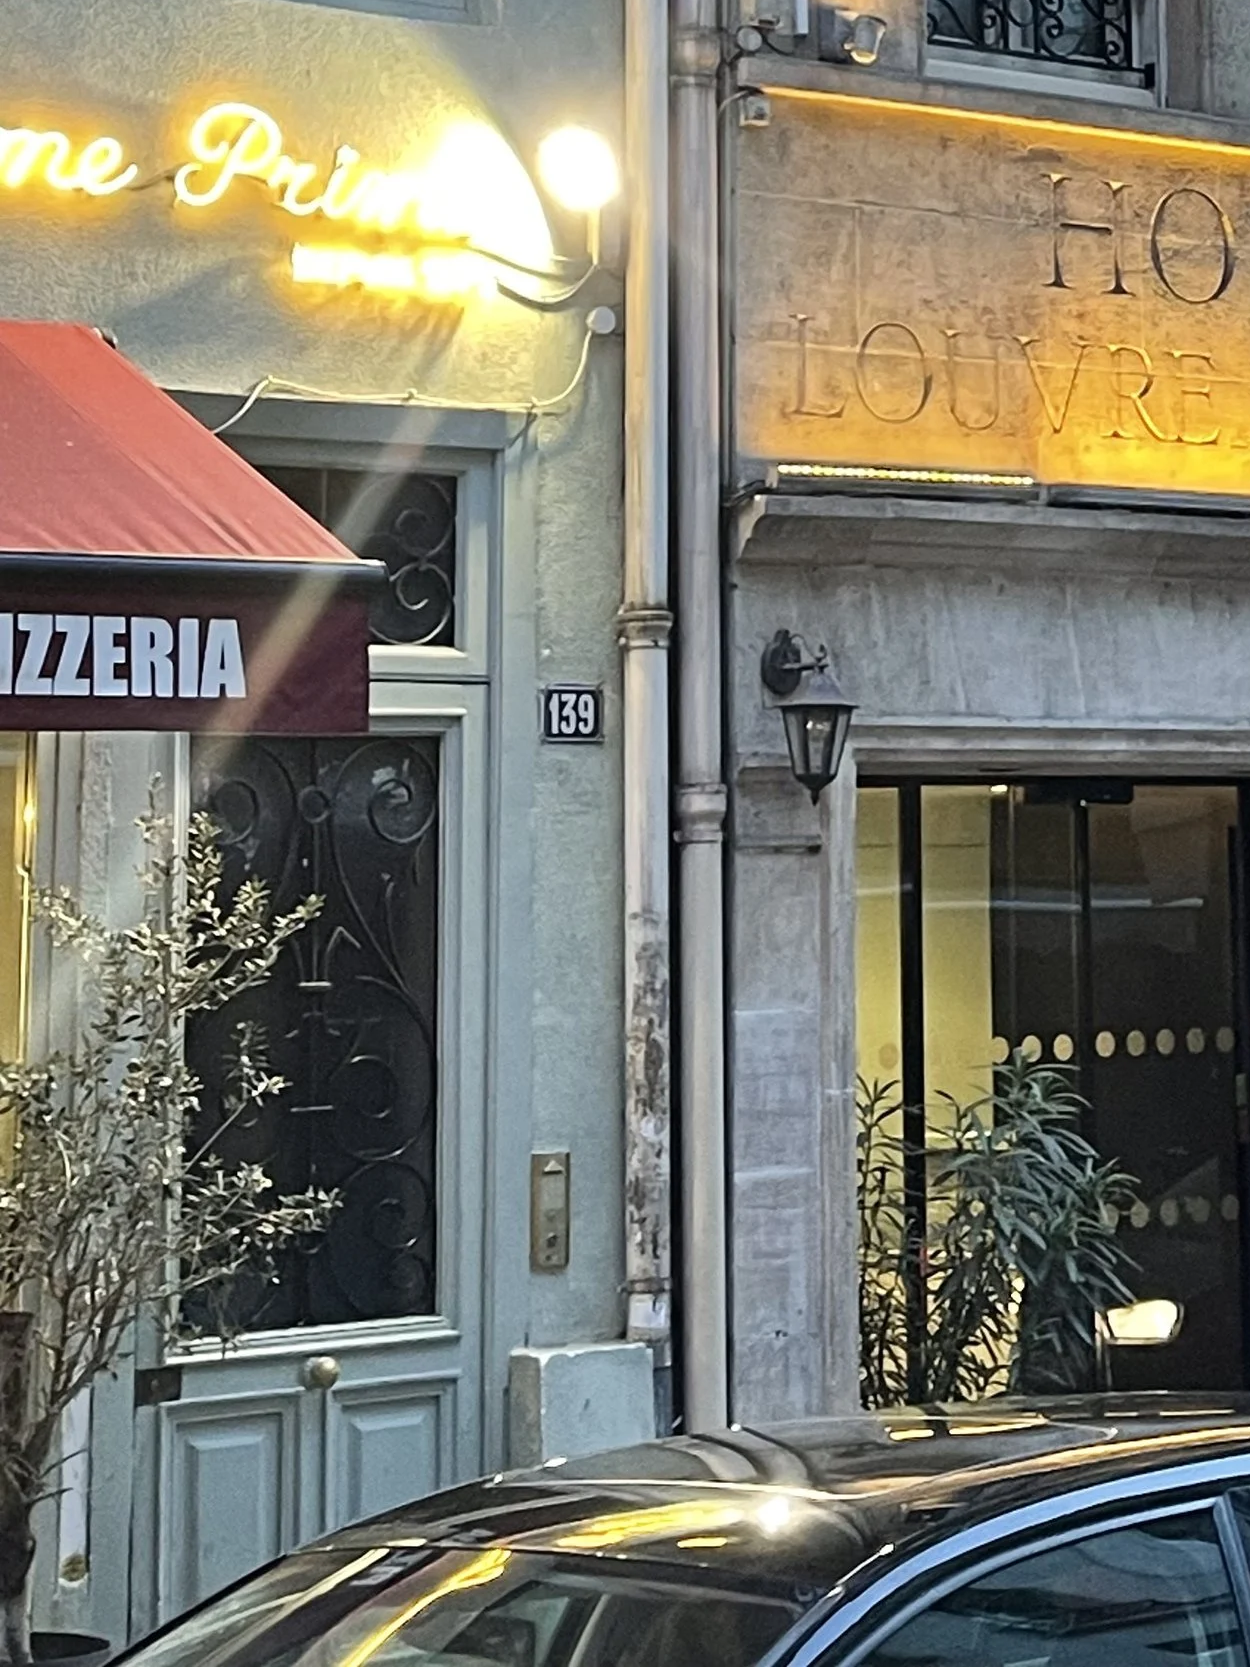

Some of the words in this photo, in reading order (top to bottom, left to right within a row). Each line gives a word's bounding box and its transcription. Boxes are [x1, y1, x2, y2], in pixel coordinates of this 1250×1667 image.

[785, 313, 1222, 446] LOUVRE
[0, 612, 247, 699] IZZERIA
[548, 692, 596, 735] 139
